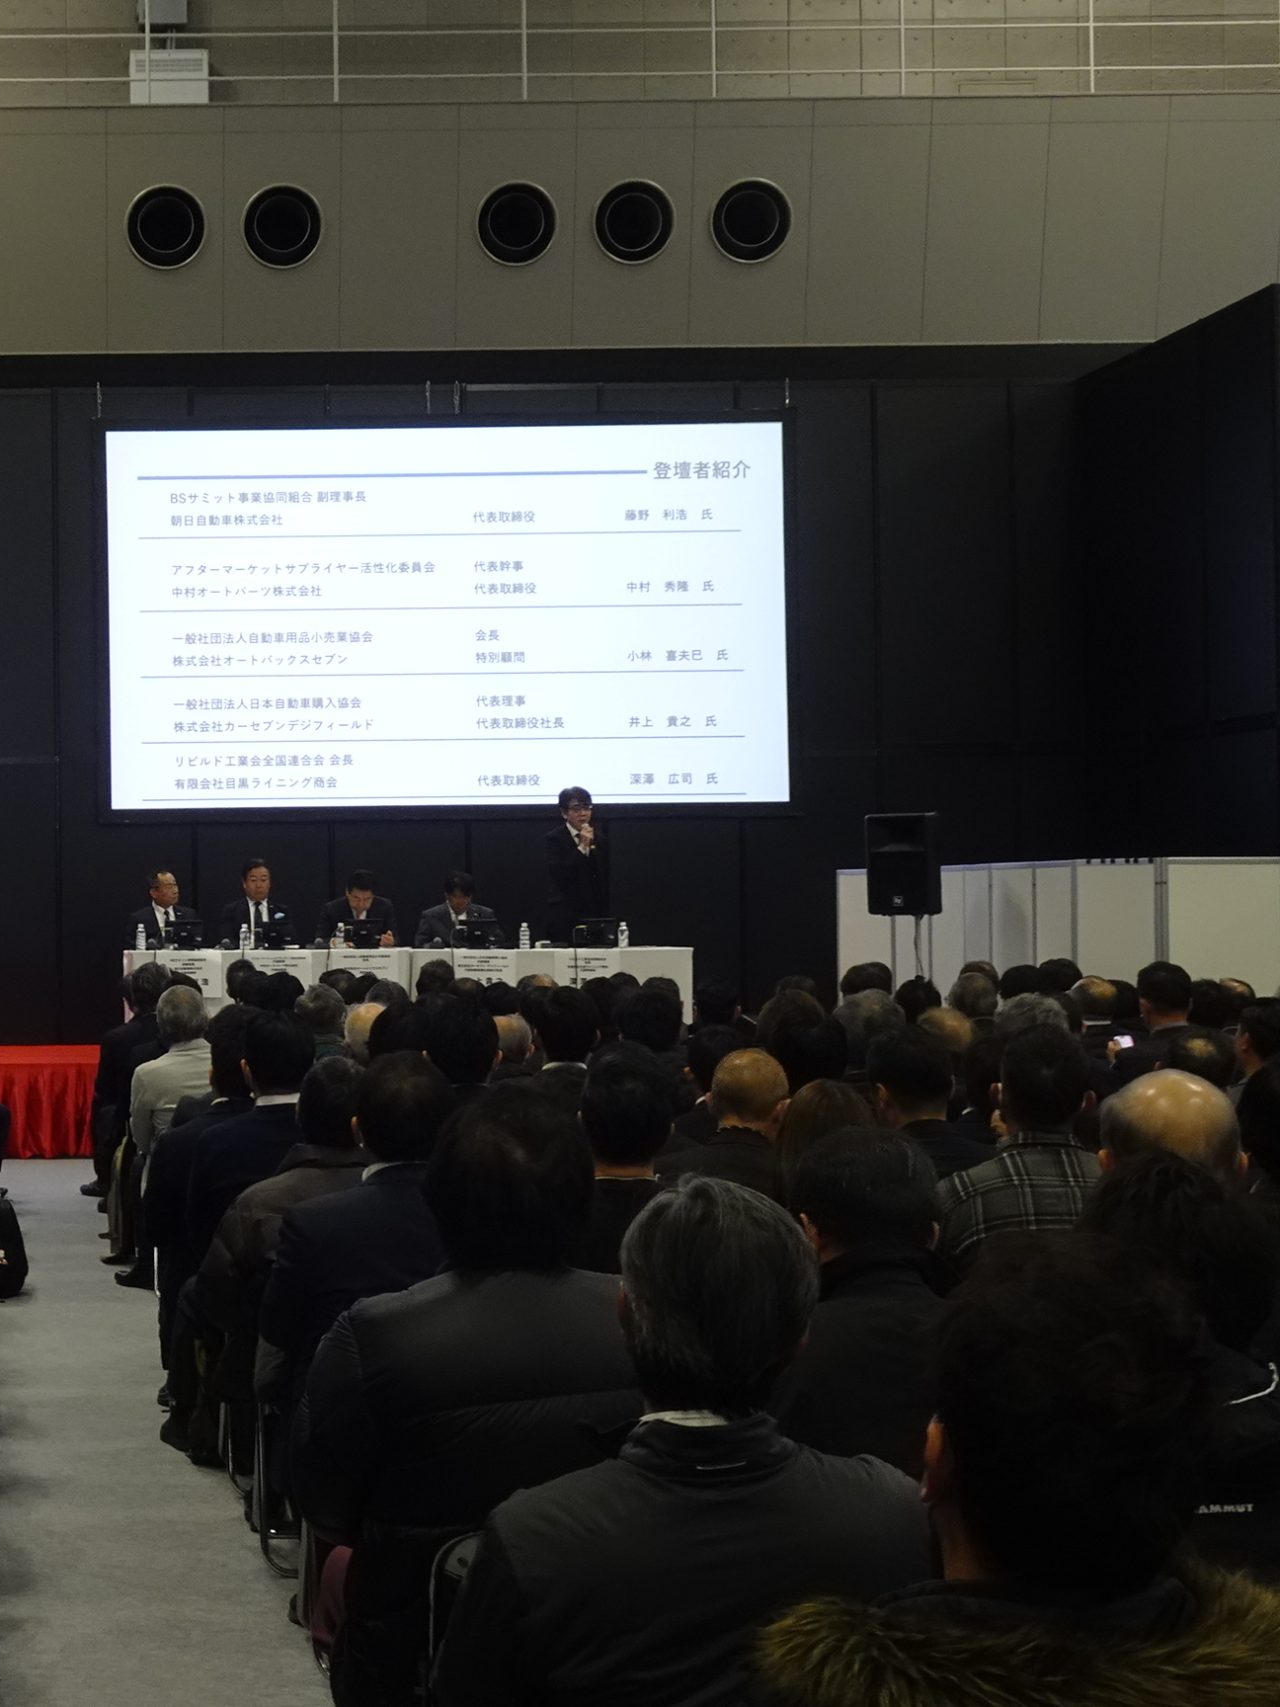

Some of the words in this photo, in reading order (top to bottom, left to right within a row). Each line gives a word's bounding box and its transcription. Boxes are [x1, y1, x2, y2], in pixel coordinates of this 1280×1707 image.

[653, 460, 751, 480] 登壇者紹介
[170, 491, 312, 504] BSサミット事業協同組合
[317, 491, 366, 503] 副理事長
[171, 514, 283, 527] 朝日自動車株式会社
[701, 508, 713, 520] 氏
[474, 561, 524, 572] 代表幹事
[627, 581, 650, 593] 中村
[703, 580, 714, 592] 氏
[172, 631, 373, 645] 一般社団法人自動車用品小売業協会
[475, 629, 499, 641] 会長
[172, 654, 347, 667] 株式会社オートバックスセブン
[475, 651, 525, 663] 特別顧問
[628, 650, 652, 662] 小林
[717, 649, 728, 661] 氏
[476, 695, 525, 707] 代表理事
[174, 719, 374, 733] 株式会社カーセブンデジフィールド
[476, 717, 564, 729] 代表取締役社長
[629, 716, 653, 728] 井上
[705, 715, 717, 727] 氏
[175, 755, 324, 768] リビルド工業会全国連合会
[330, 754, 354, 766] 会長
[668, 773, 692, 784] 広司
[706, 772, 718, 784] 氏
[1194, 1503, 1254, 1514] AMMUT
